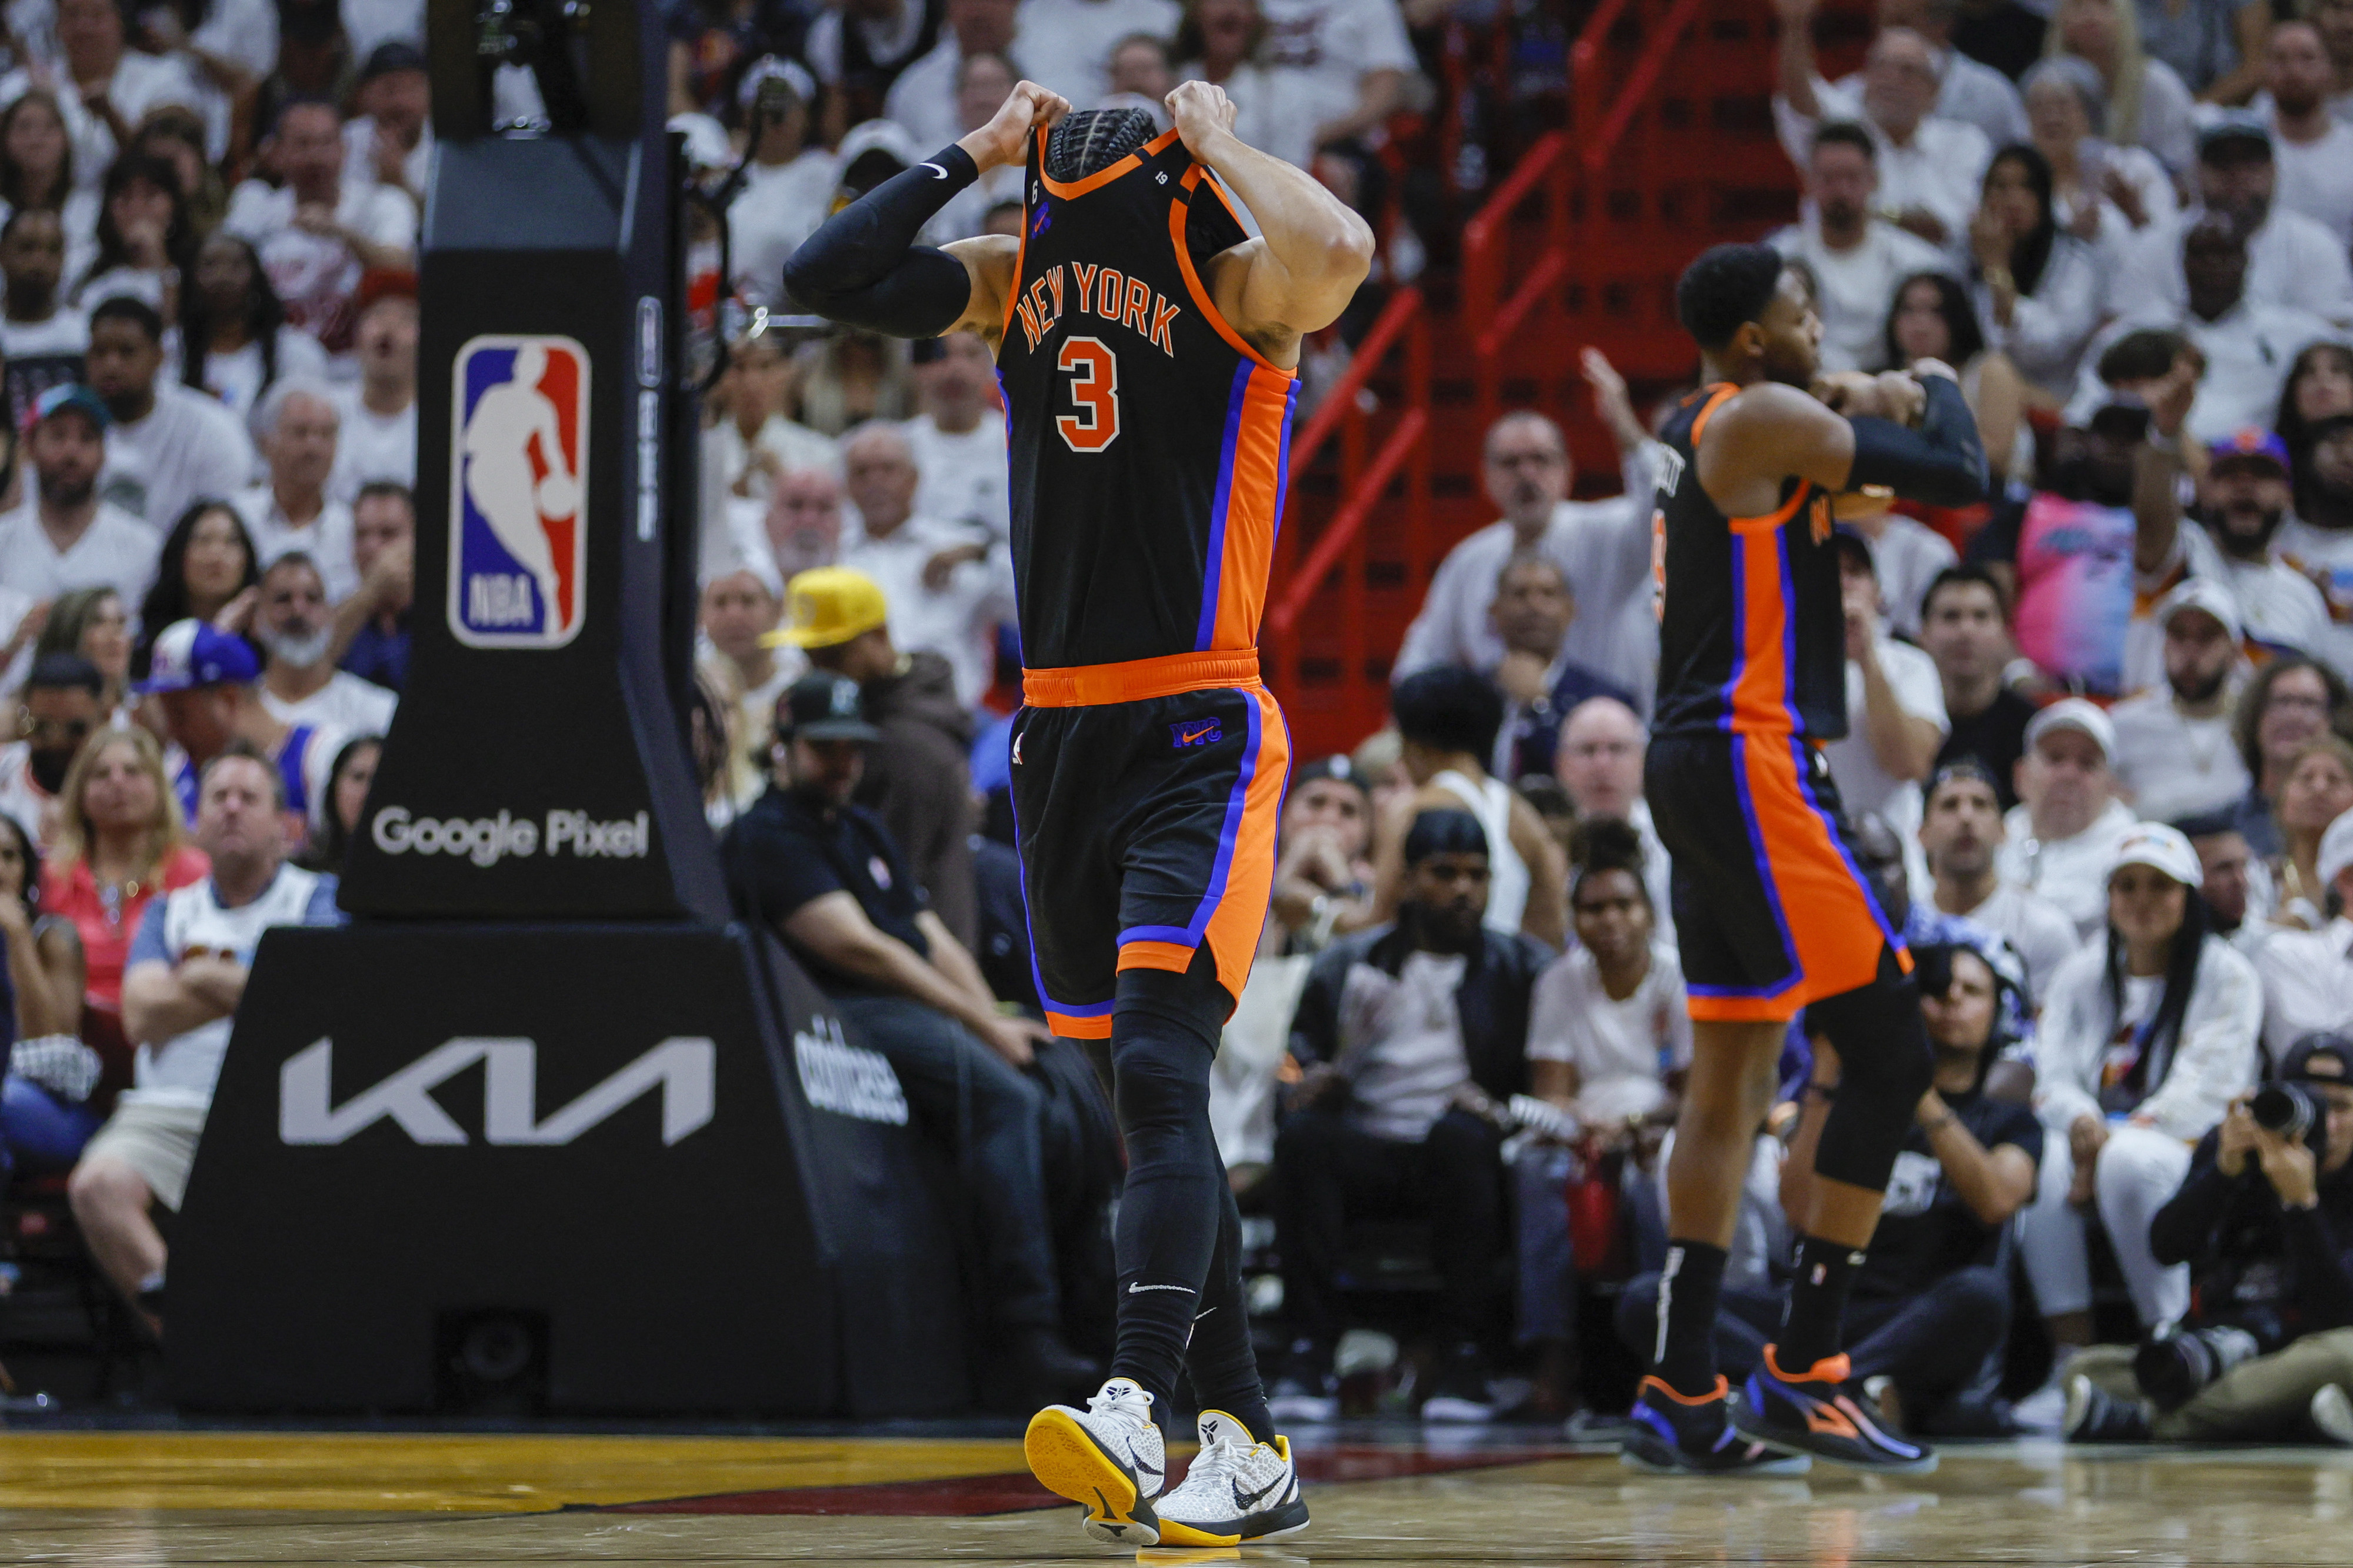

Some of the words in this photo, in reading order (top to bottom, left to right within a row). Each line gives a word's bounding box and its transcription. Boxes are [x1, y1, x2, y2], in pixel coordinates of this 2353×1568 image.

[1032, 179, 1038, 205] 6
[1155, 171, 1168, 185] 19
[1016, 265, 1064, 355] NEW
[1071, 261, 1181, 358] YORK
[1056, 336, 1120, 452] 3
[469, 572, 534, 627] NBA
[1169, 716, 1222, 748] NYC
[372, 805, 539, 868] Google
[545, 809, 649, 859] Pixel
